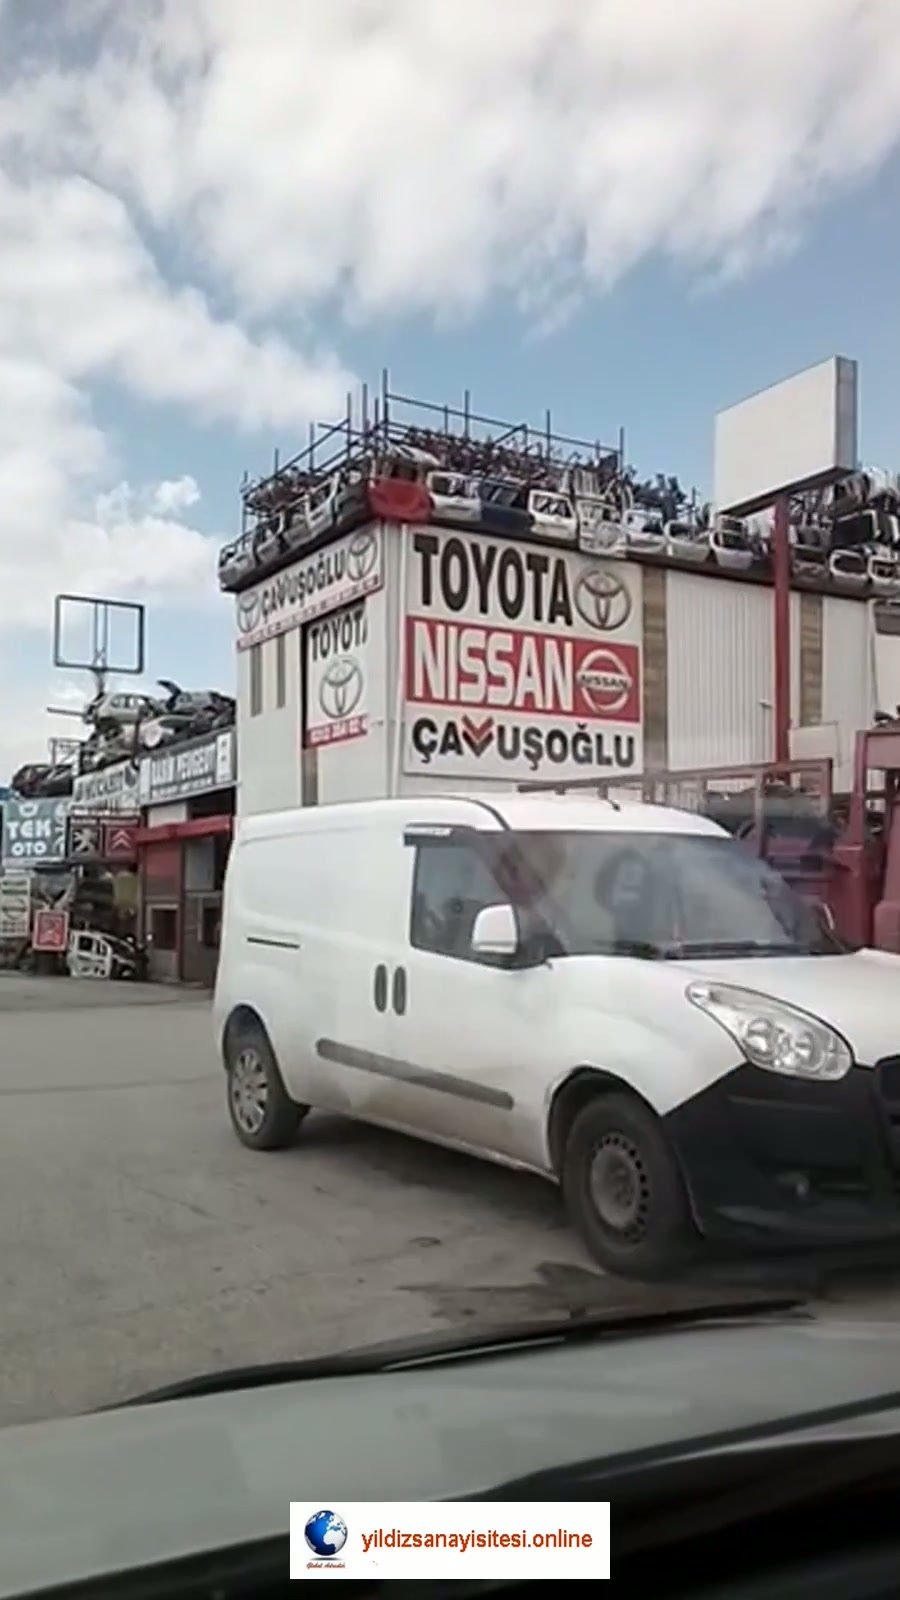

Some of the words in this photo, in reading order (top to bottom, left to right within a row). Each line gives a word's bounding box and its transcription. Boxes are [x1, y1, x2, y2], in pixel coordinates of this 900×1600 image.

[413, 533, 573, 626] TOYOTA
[413, 621, 574, 712] NISSAN
[580, 674, 628, 689] NISSAN
[6, 820, 51, 840] TEK
[11, 841, 47, 856] OTO
